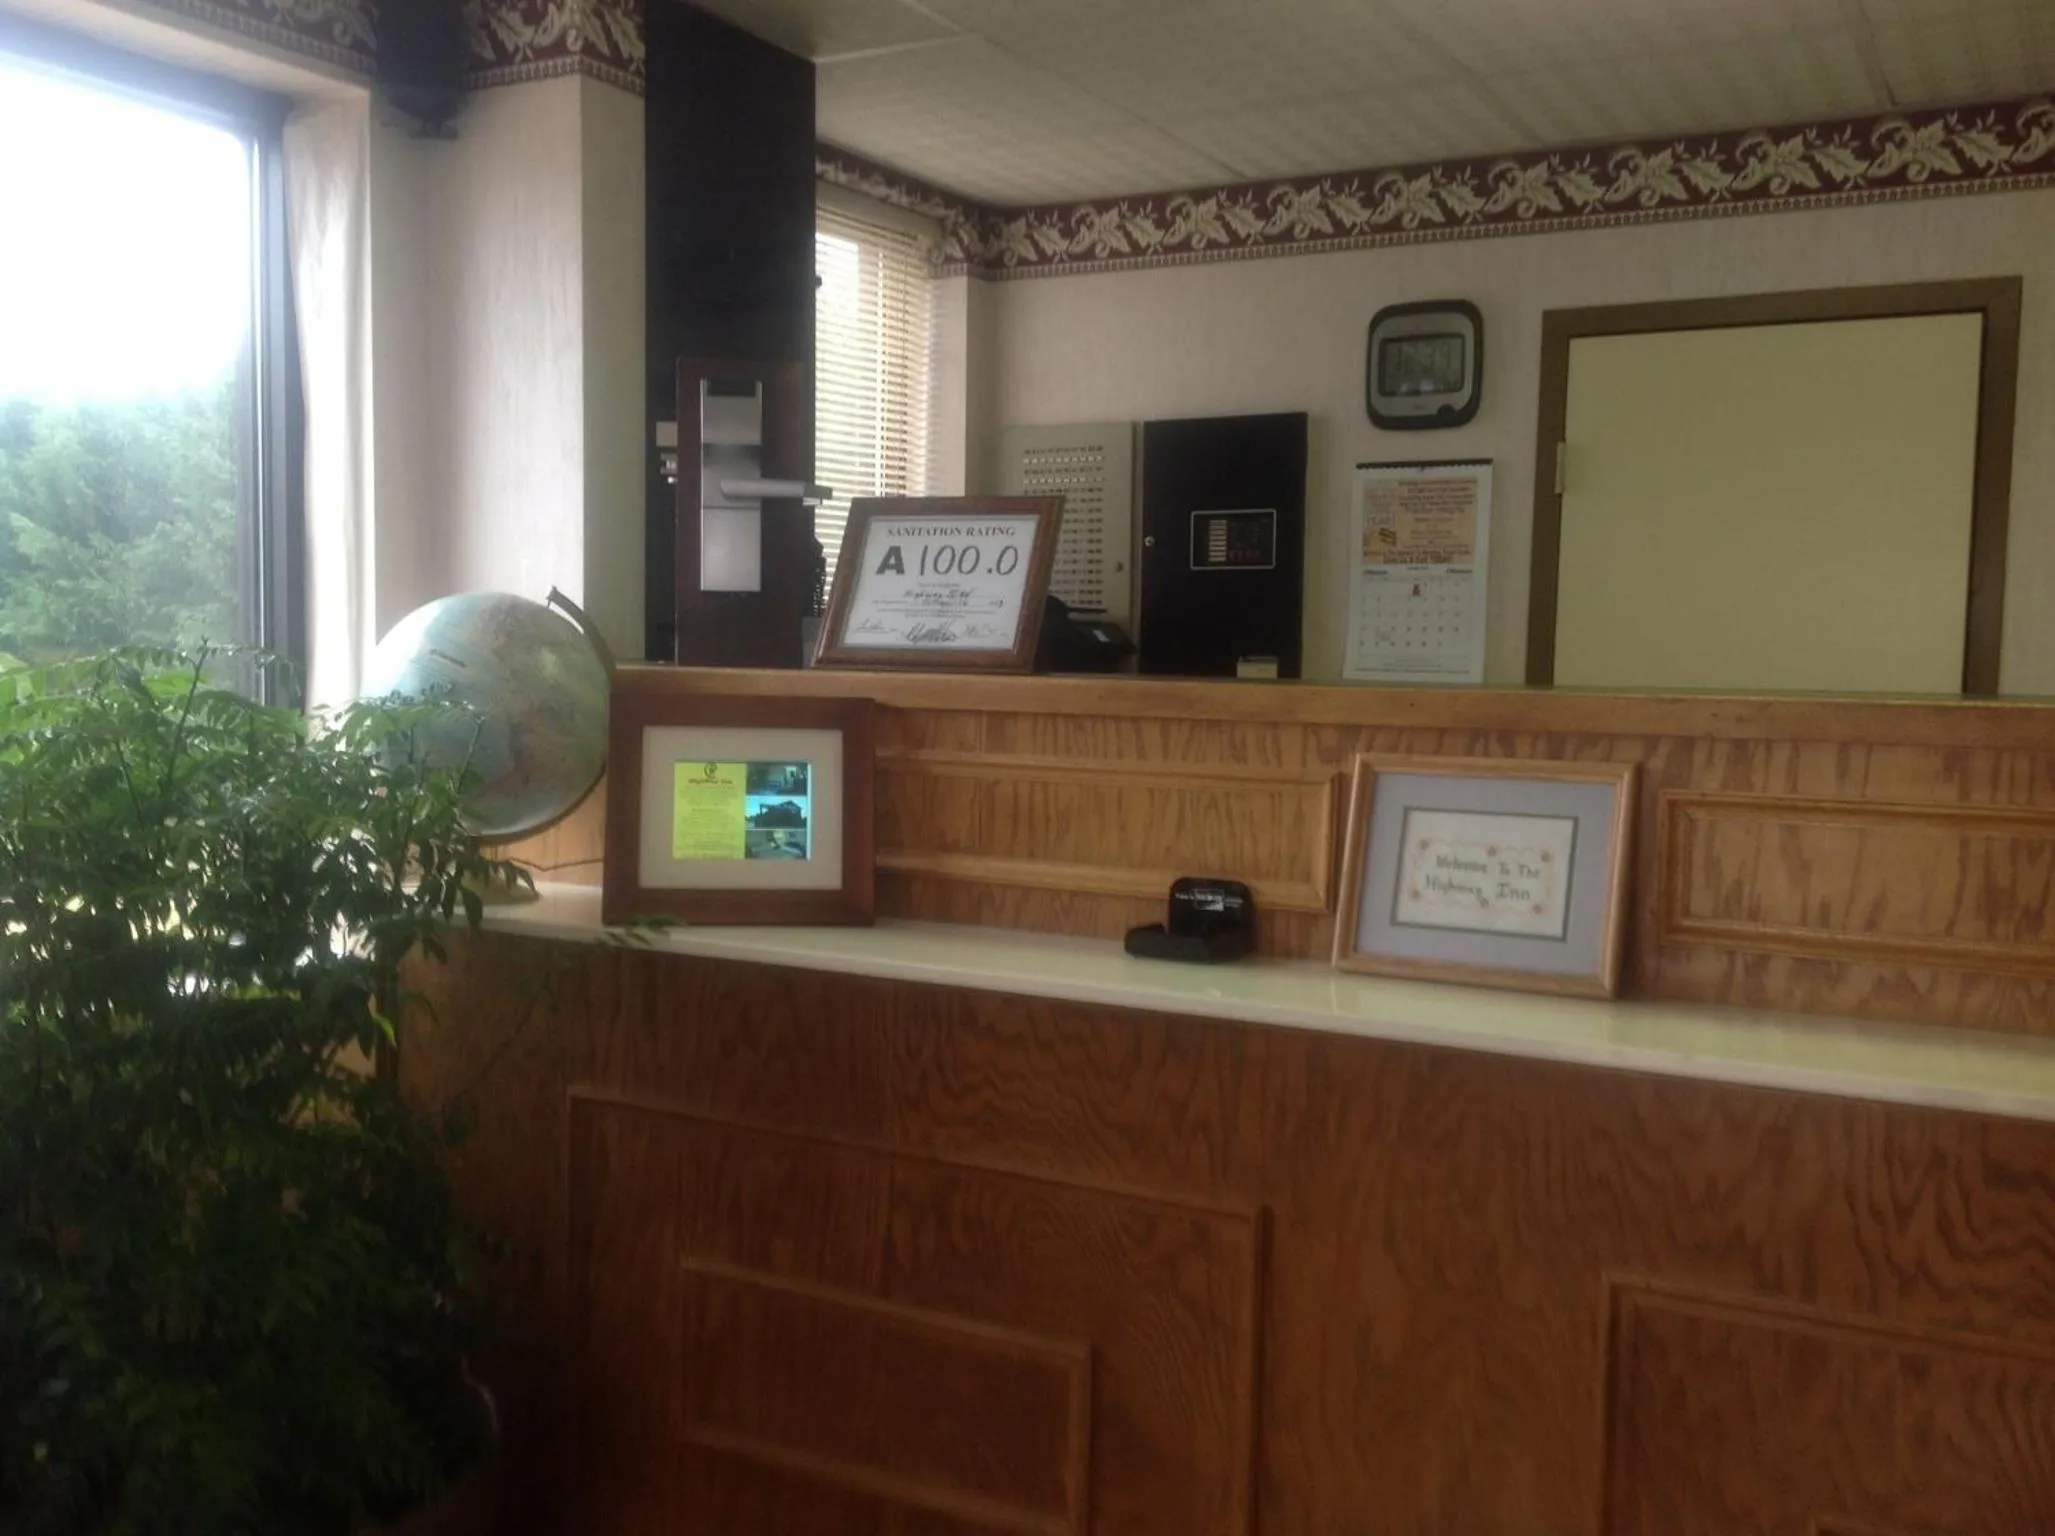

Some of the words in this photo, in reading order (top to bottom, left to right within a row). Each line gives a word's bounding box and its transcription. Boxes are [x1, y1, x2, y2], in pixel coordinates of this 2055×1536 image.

[887, 526, 961, 538] SANITATION
[966, 526, 1016, 537] RATING
[876, 545, 905, 575] A
[919, 544, 1019, 576] 100.0
[1436, 855, 1488, 874] Welcome
[1518, 864, 1541, 879] The
[1496, 882, 1531, 901] Inn
